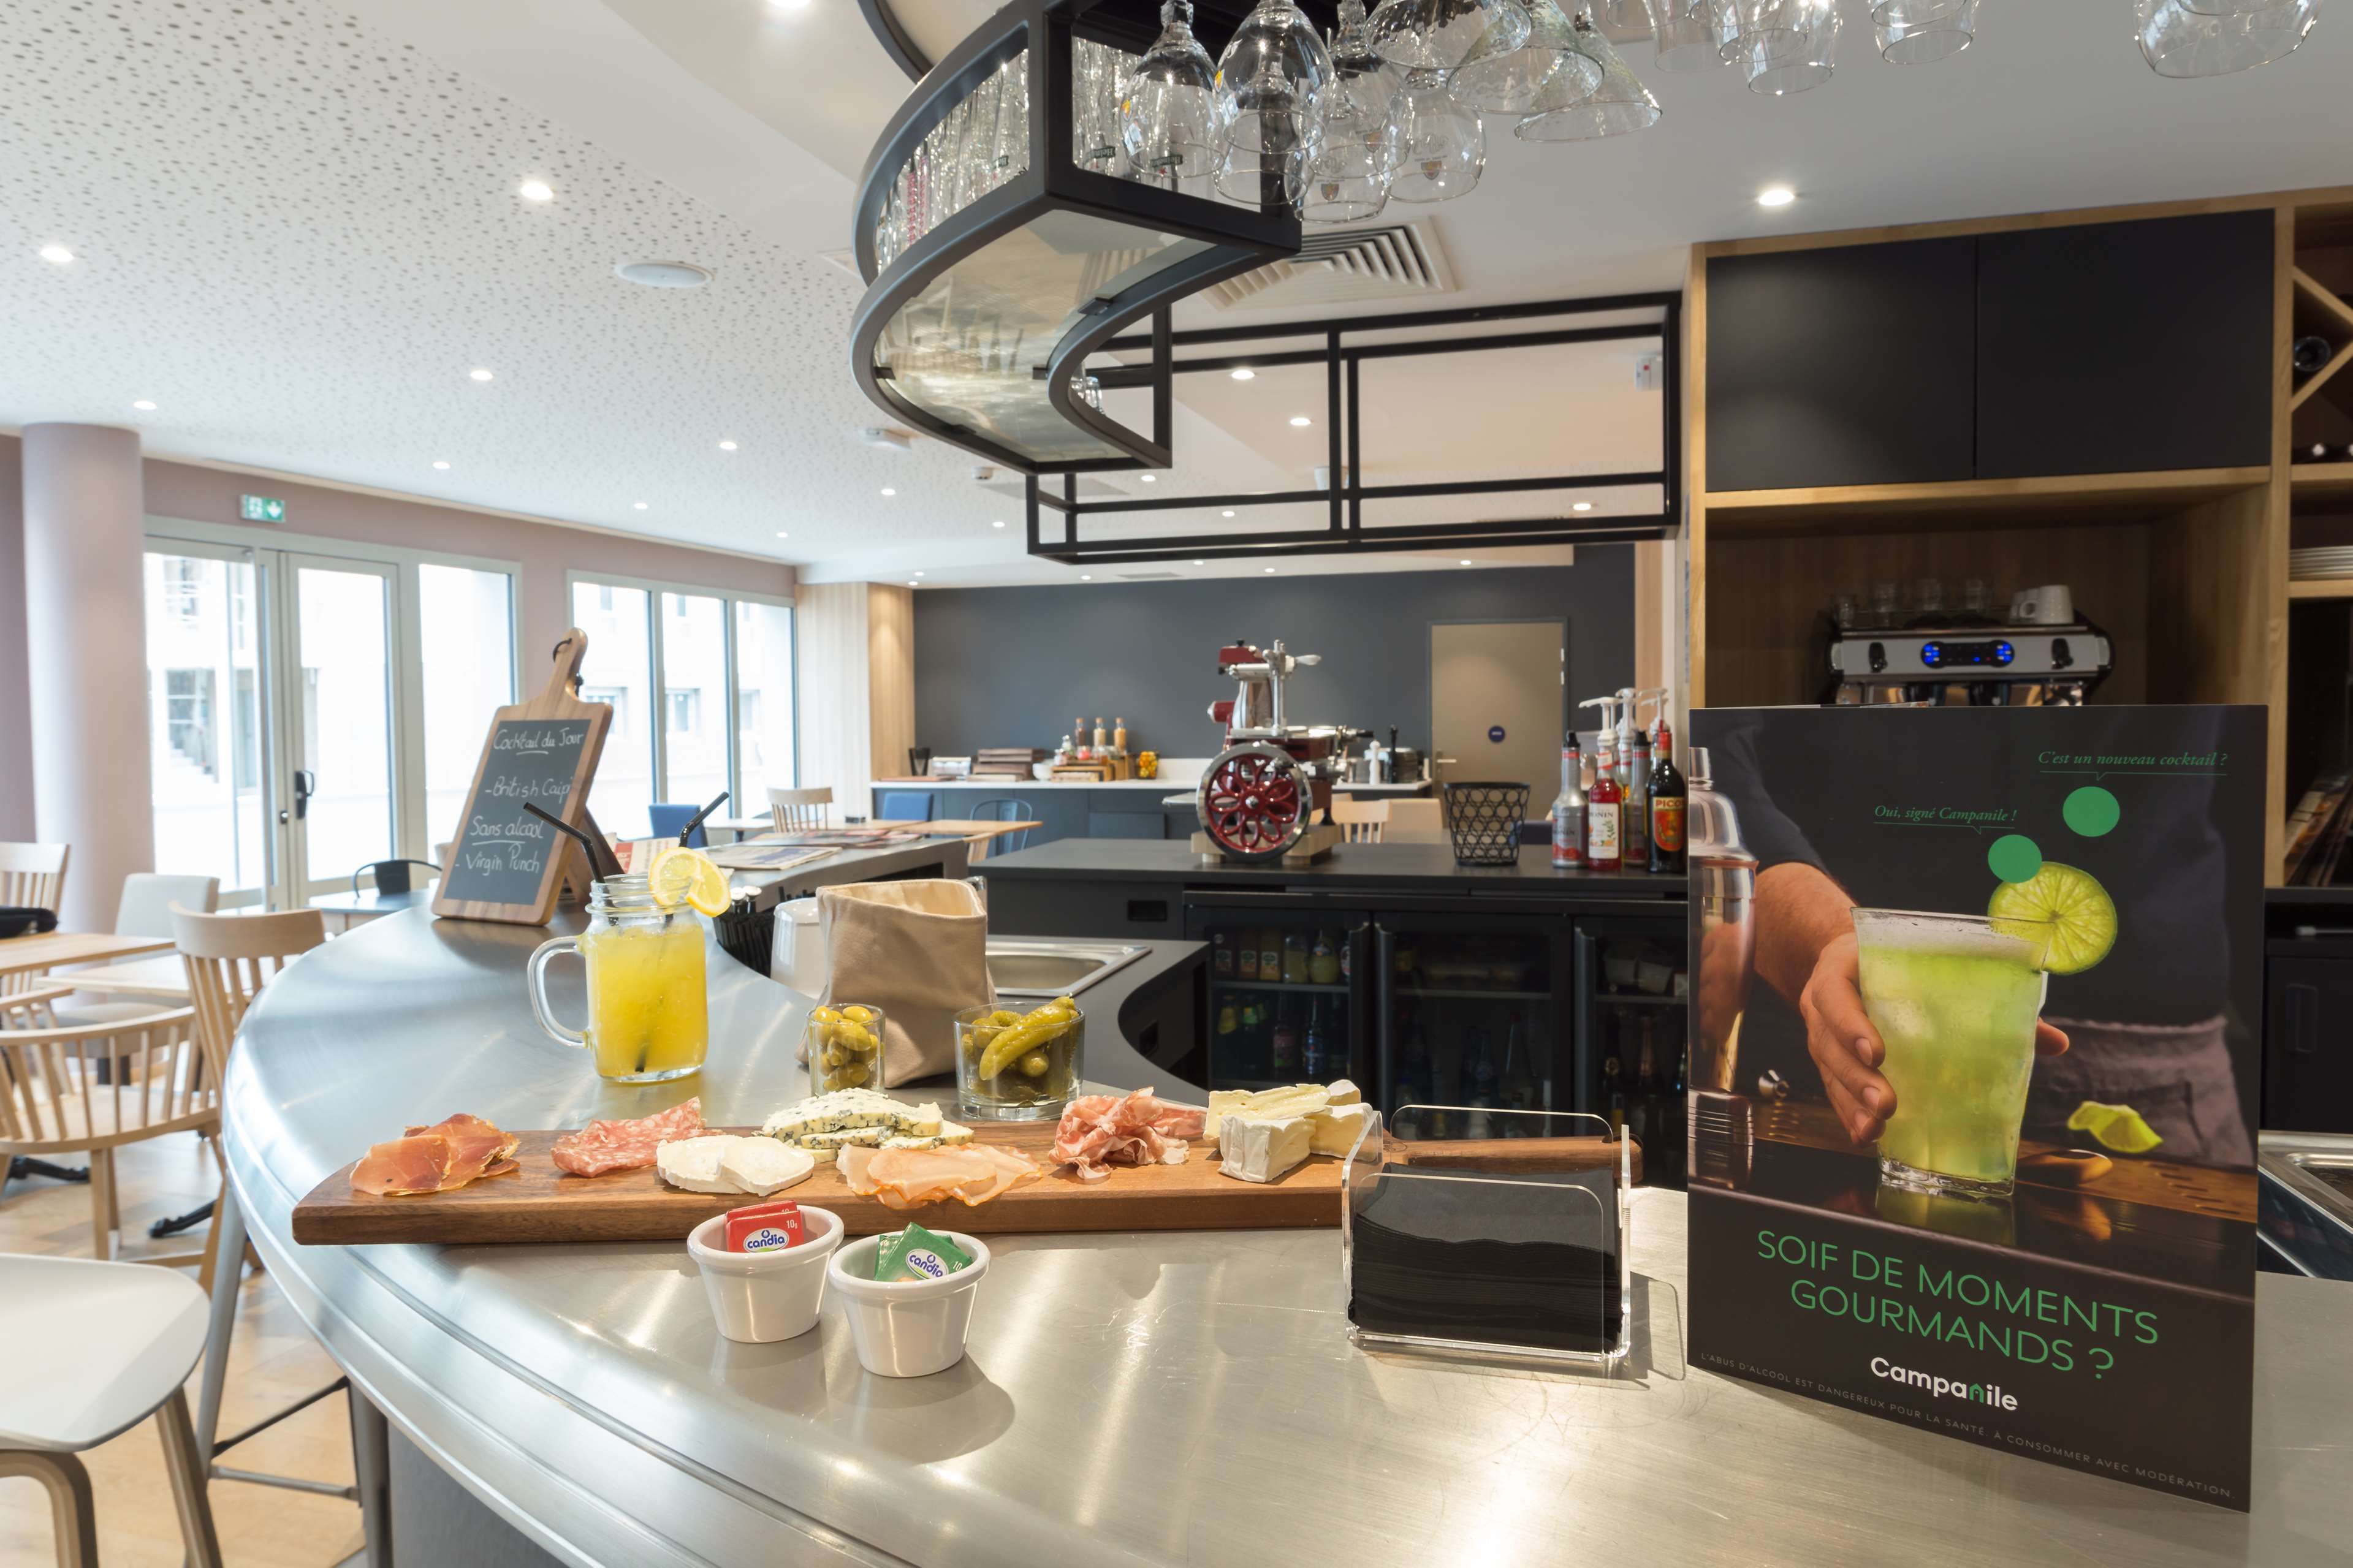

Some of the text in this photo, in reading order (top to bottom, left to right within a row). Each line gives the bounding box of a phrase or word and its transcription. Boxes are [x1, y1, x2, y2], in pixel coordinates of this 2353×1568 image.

[493, 727, 584, 749] Cocktail du Jour
[2038, 751, 2228, 766] C'est un nouveau cocktail ?
[1655, 799, 1683, 808] PICO
[1874, 805, 2017, 824] Oui, signé Campanile !
[469, 816, 502, 836] Sans
[465, 851, 502, 876] Virgin
[507, 843, 540, 873] Punch
[785, 1219, 798, 1229] 10g
[747, 1234, 785, 1248] candia
[952, 1260, 962, 1271] 10
[1757, 1230, 2158, 1344] SOIF DE MOMENTS
[1791, 1279, 2114, 1379] GOURMANDS ?
[1871, 1357, 2018, 1411] Campanile
[1701, 1352, 1735, 1368] L'ABUS
[1739, 1362, 1791, 1382] D'ALCOOL
[1795, 1377, 1813, 1388] EST
[1818, 1383, 1885, 1409] DANGEREUX
[1890, 1403, 1922, 1419] POUR
[1926, 1413, 1941, 1424] LA
[2007, 1434, 2091, 1463] CONSOMMER
[2096, 1458, 2129, 1473] AVEC
[2135, 1467, 2236, 1499] MODÉRATION.
